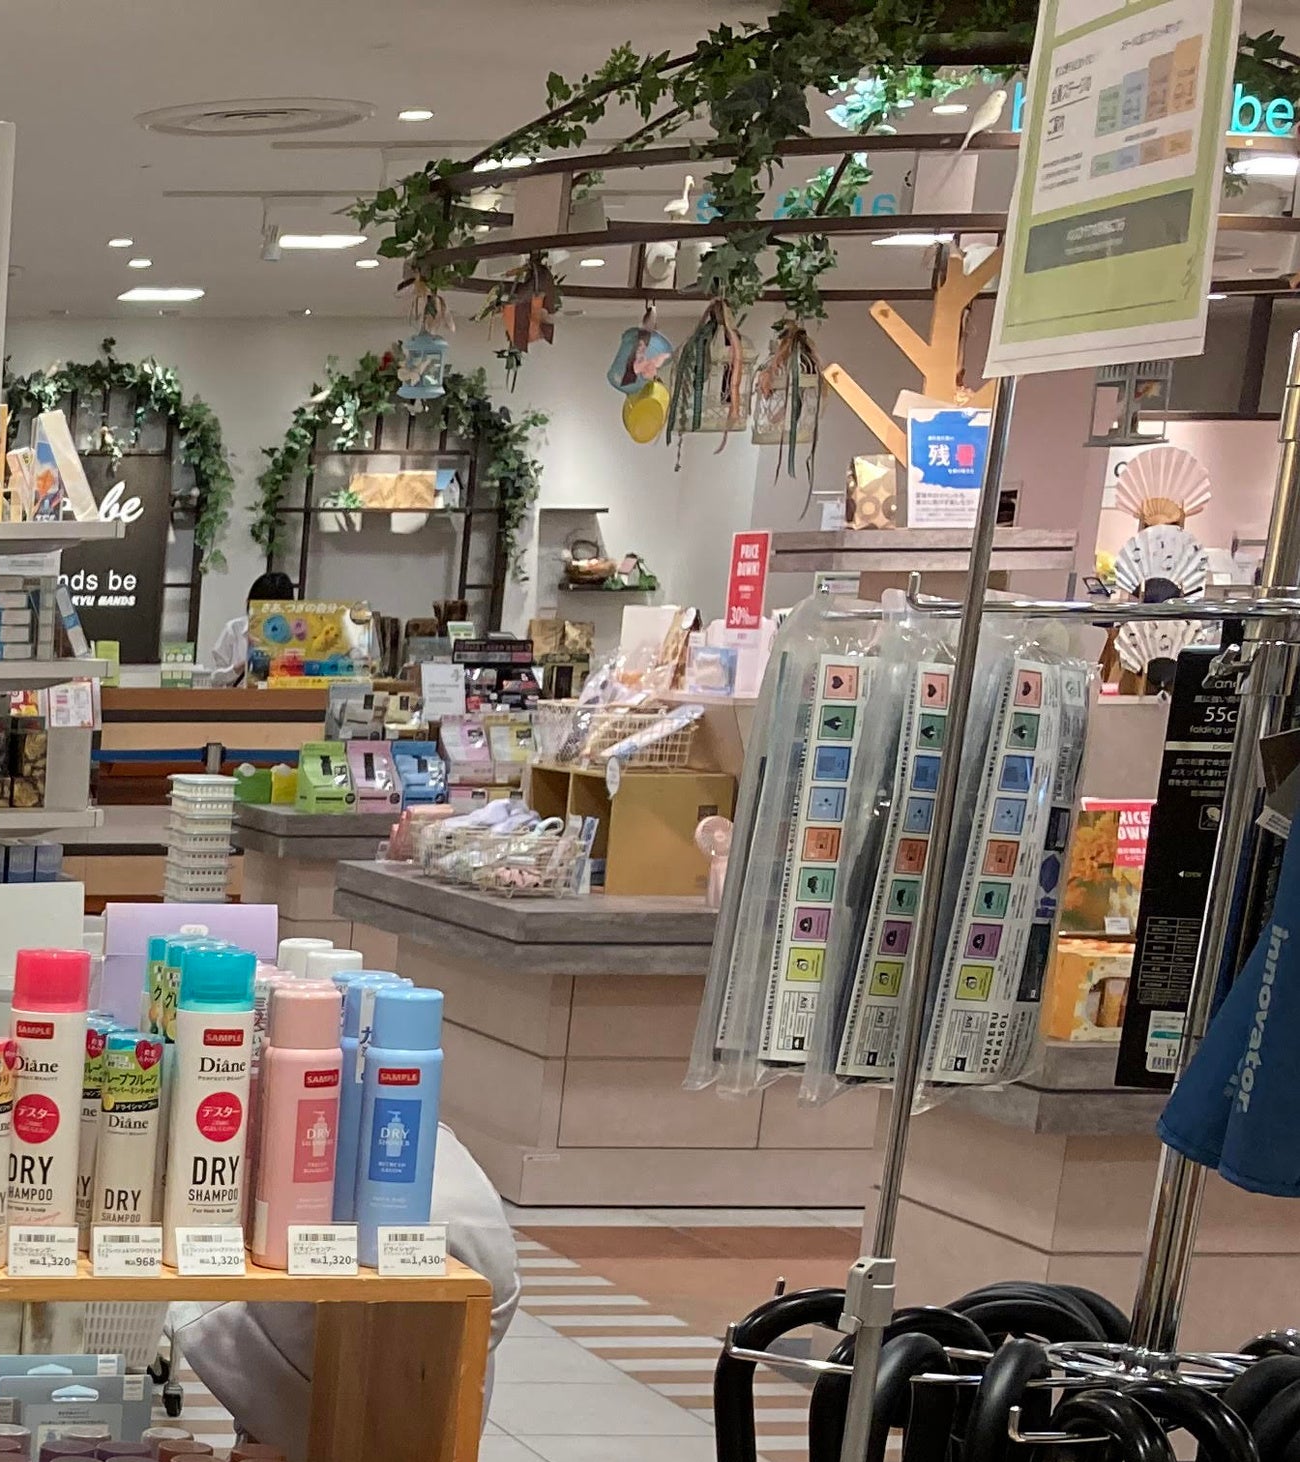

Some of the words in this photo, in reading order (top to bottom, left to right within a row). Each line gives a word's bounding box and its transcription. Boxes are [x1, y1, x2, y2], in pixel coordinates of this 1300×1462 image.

[1232, 84, 1293, 134] be
[57, 568, 98, 590] nds
[108, 569, 136, 590] be
[1204, 707, 1237, 722] 55c
[1238, 924, 1289, 1113] innovator
[19, 1106, 57, 1120] テスター
[9, 1153, 54, 1185] DRY
[8, 1188, 53, 1201] HAMPOO
